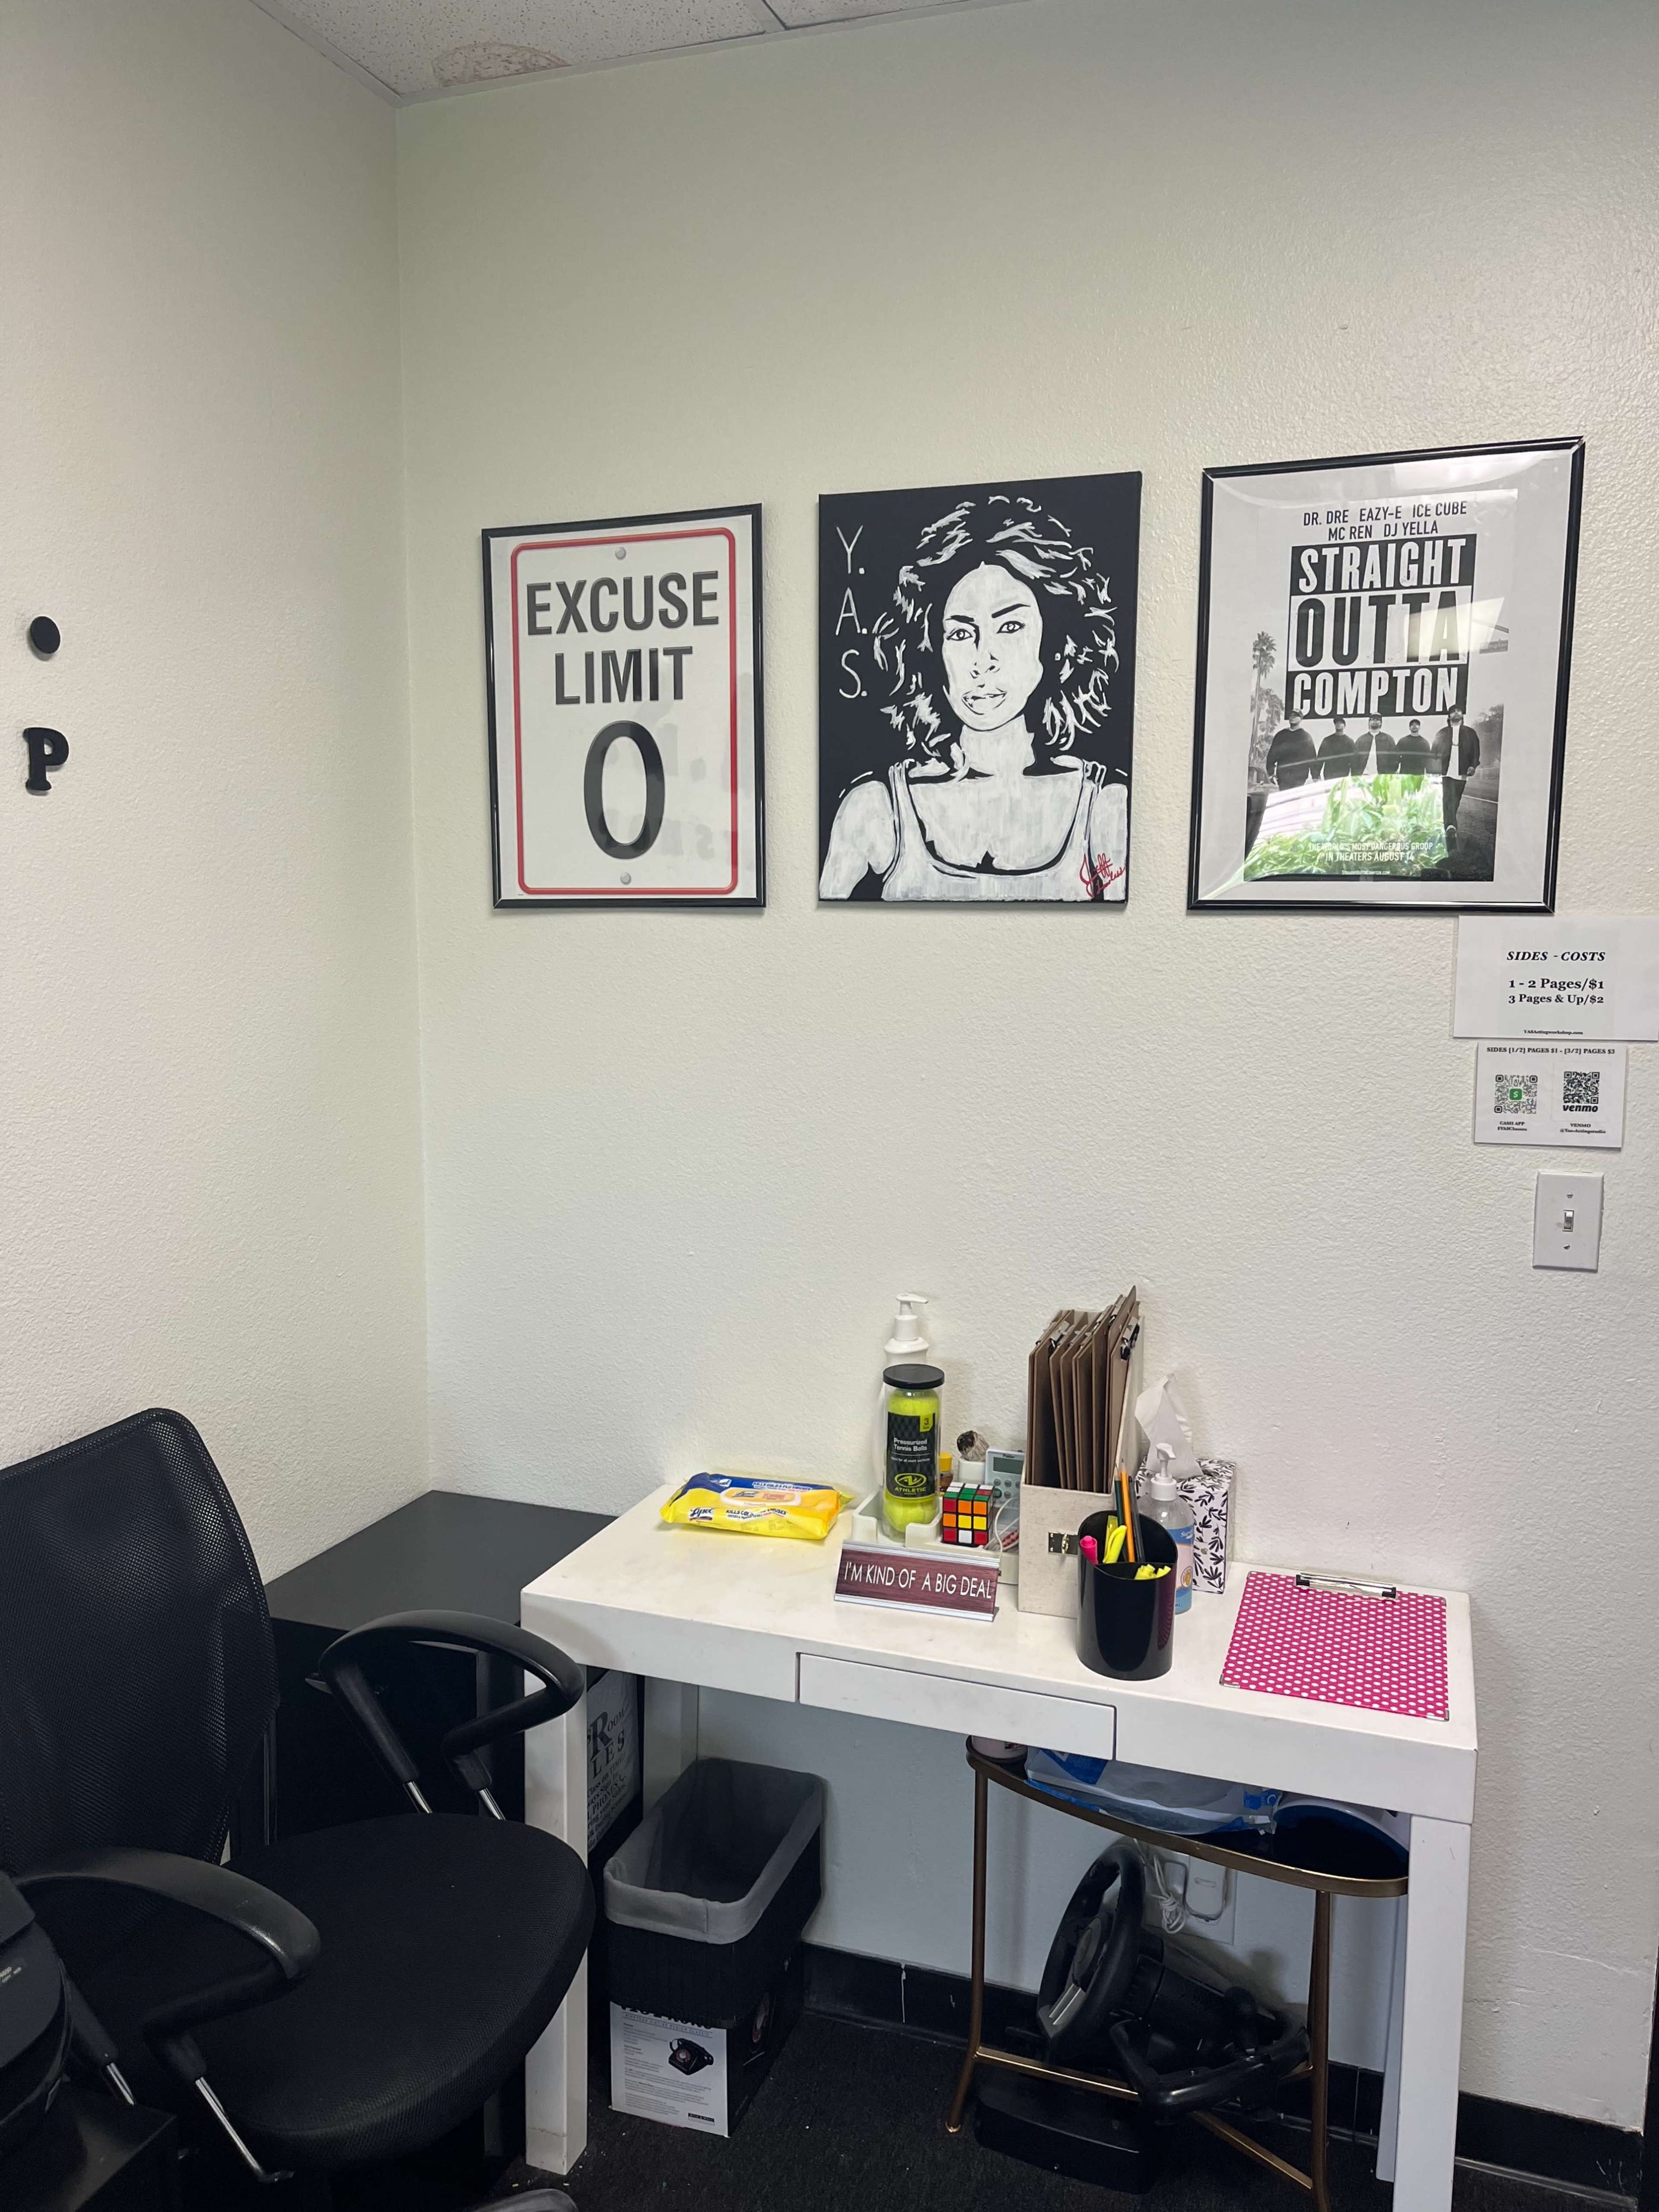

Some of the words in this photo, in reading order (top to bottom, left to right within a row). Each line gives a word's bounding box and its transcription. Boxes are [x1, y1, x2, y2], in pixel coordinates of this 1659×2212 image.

[1303, 512, 1322, 526] DR.
[1326, 509, 1349, 524] DRE
[1360, 505, 1402, 522] EAZY-E
[1413, 503, 1431, 518] ICE
[1436, 501, 1467, 516] CUBE
[1328, 528, 1345, 541] MC
[1350, 525, 1372, 539] REN
[1384, 523, 1397, 537] DJ
[1402, 520, 1438, 535] YELLA
[1298, 537, 1467, 594] STRAIGHT
[526, 570, 719, 636] EXCUSE
[1297, 590, 1461, 668] OUTTA
[554, 646, 693, 705] LIMIT
[1293, 667, 1458, 715] COMPTON
[23, 728, 69, 790] P
[1326, 852, 1334, 861] IN
[1335, 852, 1372, 861] THEATERS
[1374, 852, 1405, 861] AUGUST
[1406, 852, 1414, 861] 14
[1506, 951, 1548, 960] SIDES
[1560, 951, 1605, 962] COSTS
[1509, 995, 1515, 1004] 3
[1519, 994, 1552, 1004] Pages
[1555, 995, 1564, 1003] &
[1567, 995, 1604, 1005] Up/$2
[1540, 978, 1604, 991] Pages/$1
[690, 1508, 712, 1517] Lysol
[844, 1562, 862, 1582] I'M
[865, 1564, 895, 1586] KIND
[898, 1568, 916, 1589] OF
[922, 1573, 931, 1591] A
[935, 1573, 957, 1594] BIG
[960, 1577, 992, 1599] DEAL
